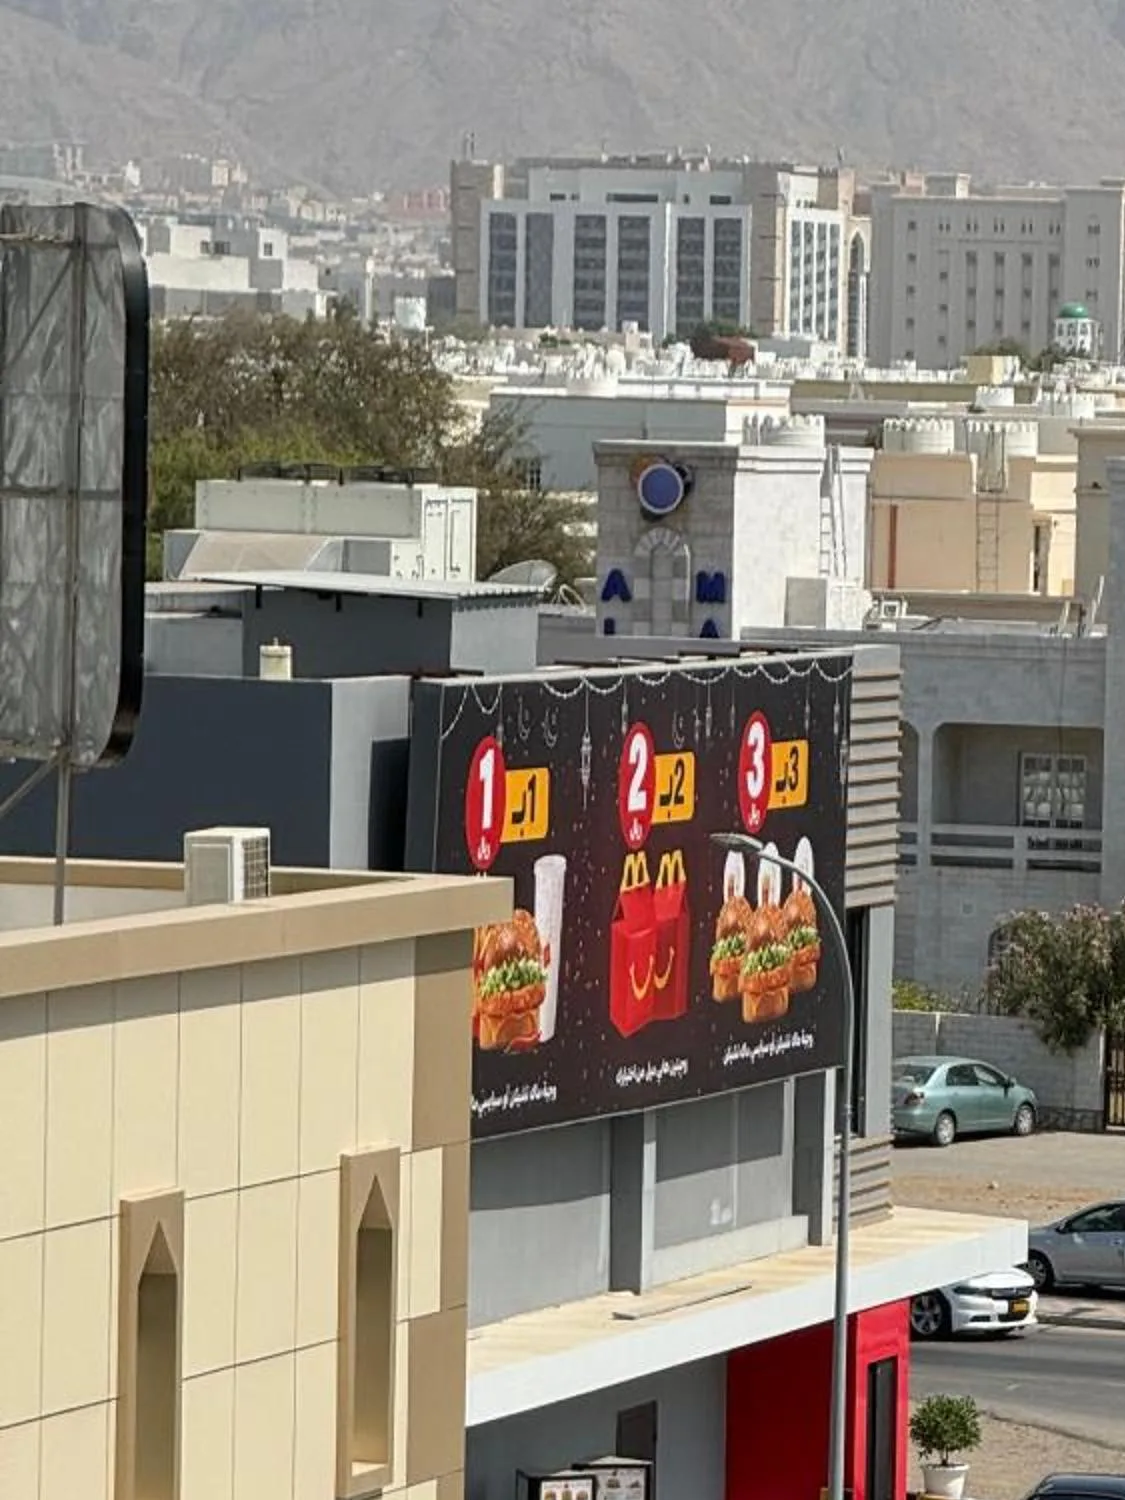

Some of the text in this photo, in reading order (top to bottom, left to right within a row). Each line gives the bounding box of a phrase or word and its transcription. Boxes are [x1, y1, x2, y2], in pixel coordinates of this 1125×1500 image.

[479, 749, 495, 830] 1
[628, 733, 648, 812] 2
[746, 721, 765, 799] 3
